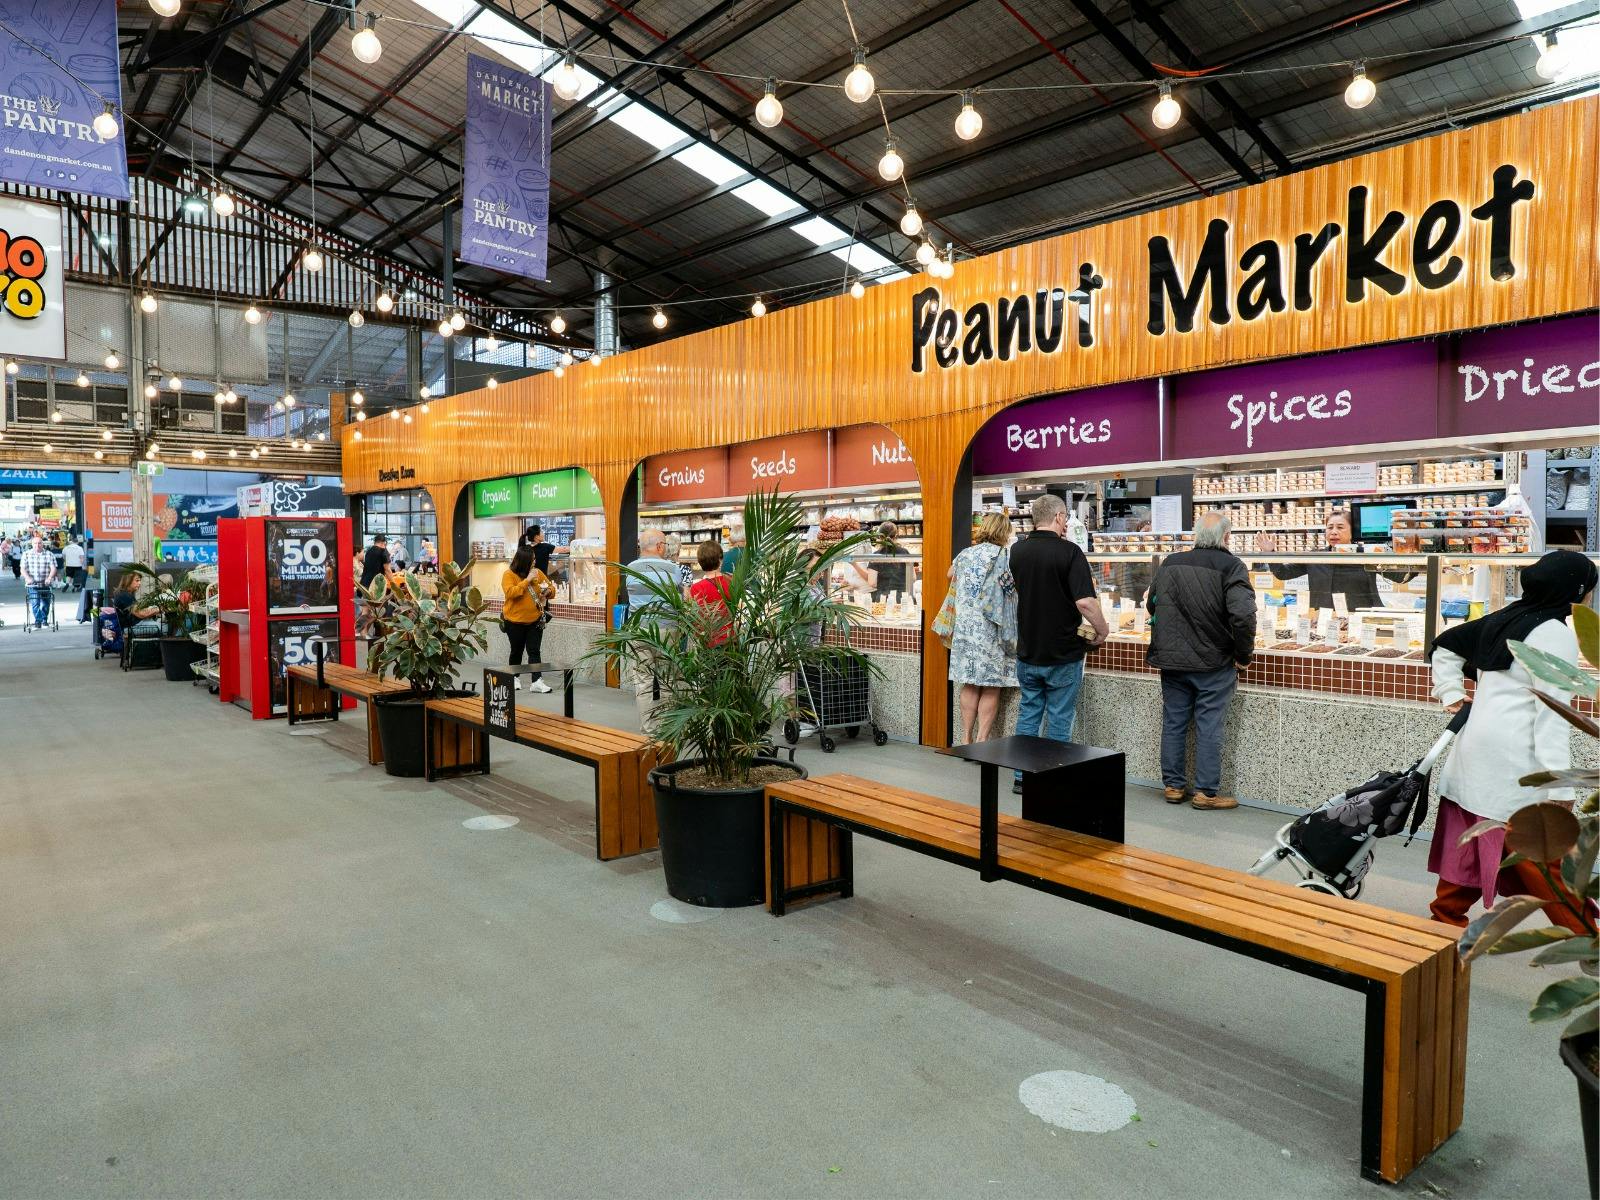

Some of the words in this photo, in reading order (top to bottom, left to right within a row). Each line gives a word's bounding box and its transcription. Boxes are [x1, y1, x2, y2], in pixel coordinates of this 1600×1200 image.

[0, 94, 37, 113] THE
[481, 81, 539, 114] MARKET
[4, 147, 112, 172] dandenongmarket.com.au
[473, 198, 496, 212] THE
[474, 208, 537, 238] PANTRY
[0, 228, 47, 280] O
[912, 262, 1103, 372] Peanut
[1147, 164, 1534, 336] Market
[0, 273, 45, 319] O
[1228, 389, 1352, 447] Spices
[1006, 418, 1110, 452] Berries
[659, 466, 705, 487] Grains
[751, 450, 796, 479] Seeds
[482, 488, 511, 509] Organic
[532, 482, 557, 499] Flour
[107, 506, 133, 516] marke
[107, 517, 133, 529] squar
[277, 538, 327, 566] $50
[281, 565, 326, 575] MILLION
